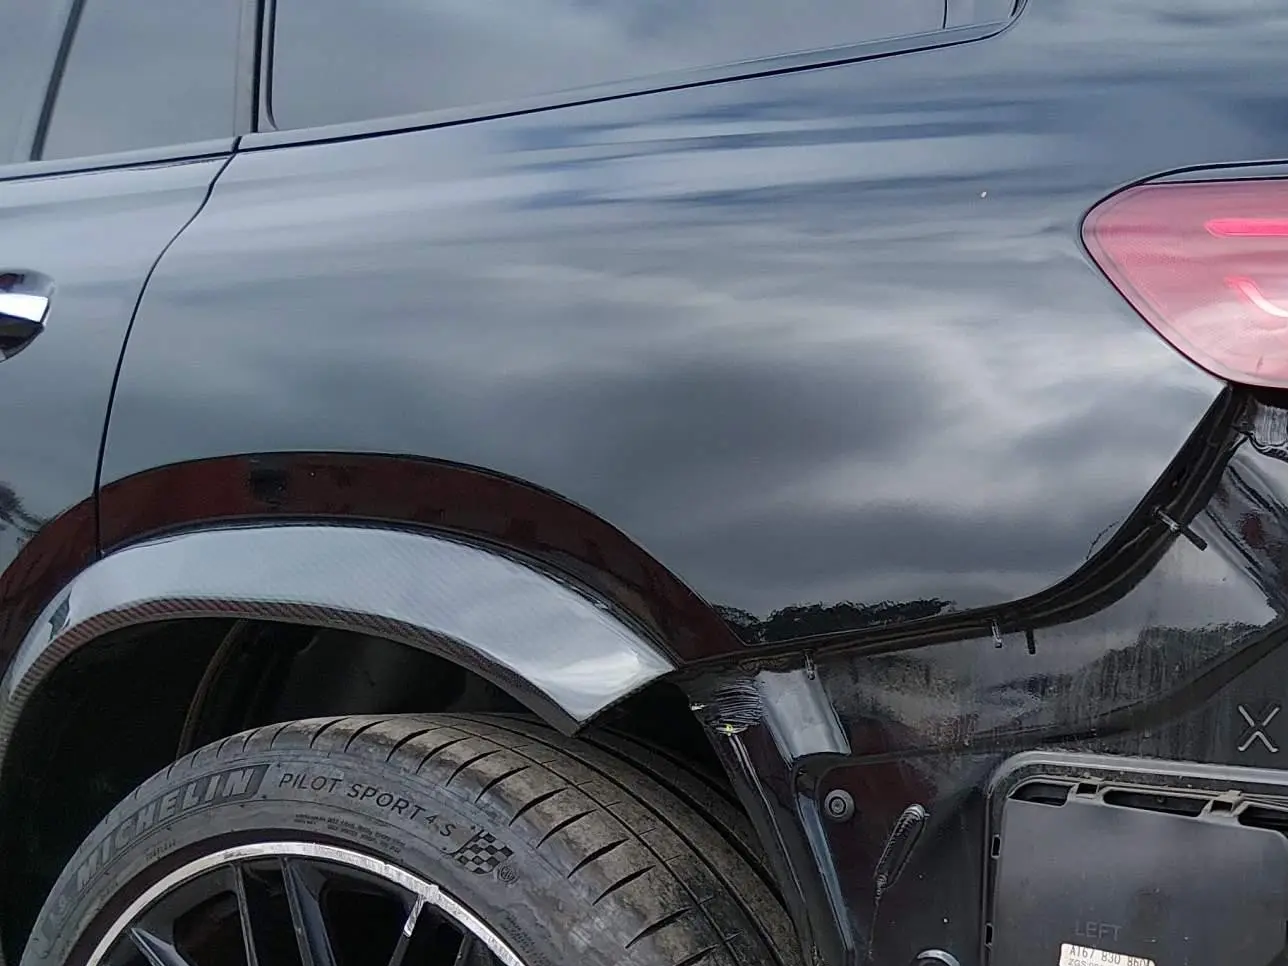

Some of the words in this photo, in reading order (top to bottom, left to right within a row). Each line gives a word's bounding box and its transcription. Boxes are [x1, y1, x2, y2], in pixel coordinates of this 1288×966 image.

[77, 768, 256, 892] MICHELIN
[278, 773, 342, 793] PILOT
[347, 783, 426, 820] SPORT
[425, 814, 438, 825] 4
[439, 823, 457, 838] S
[1075, 921, 1122, 942] LEFT
